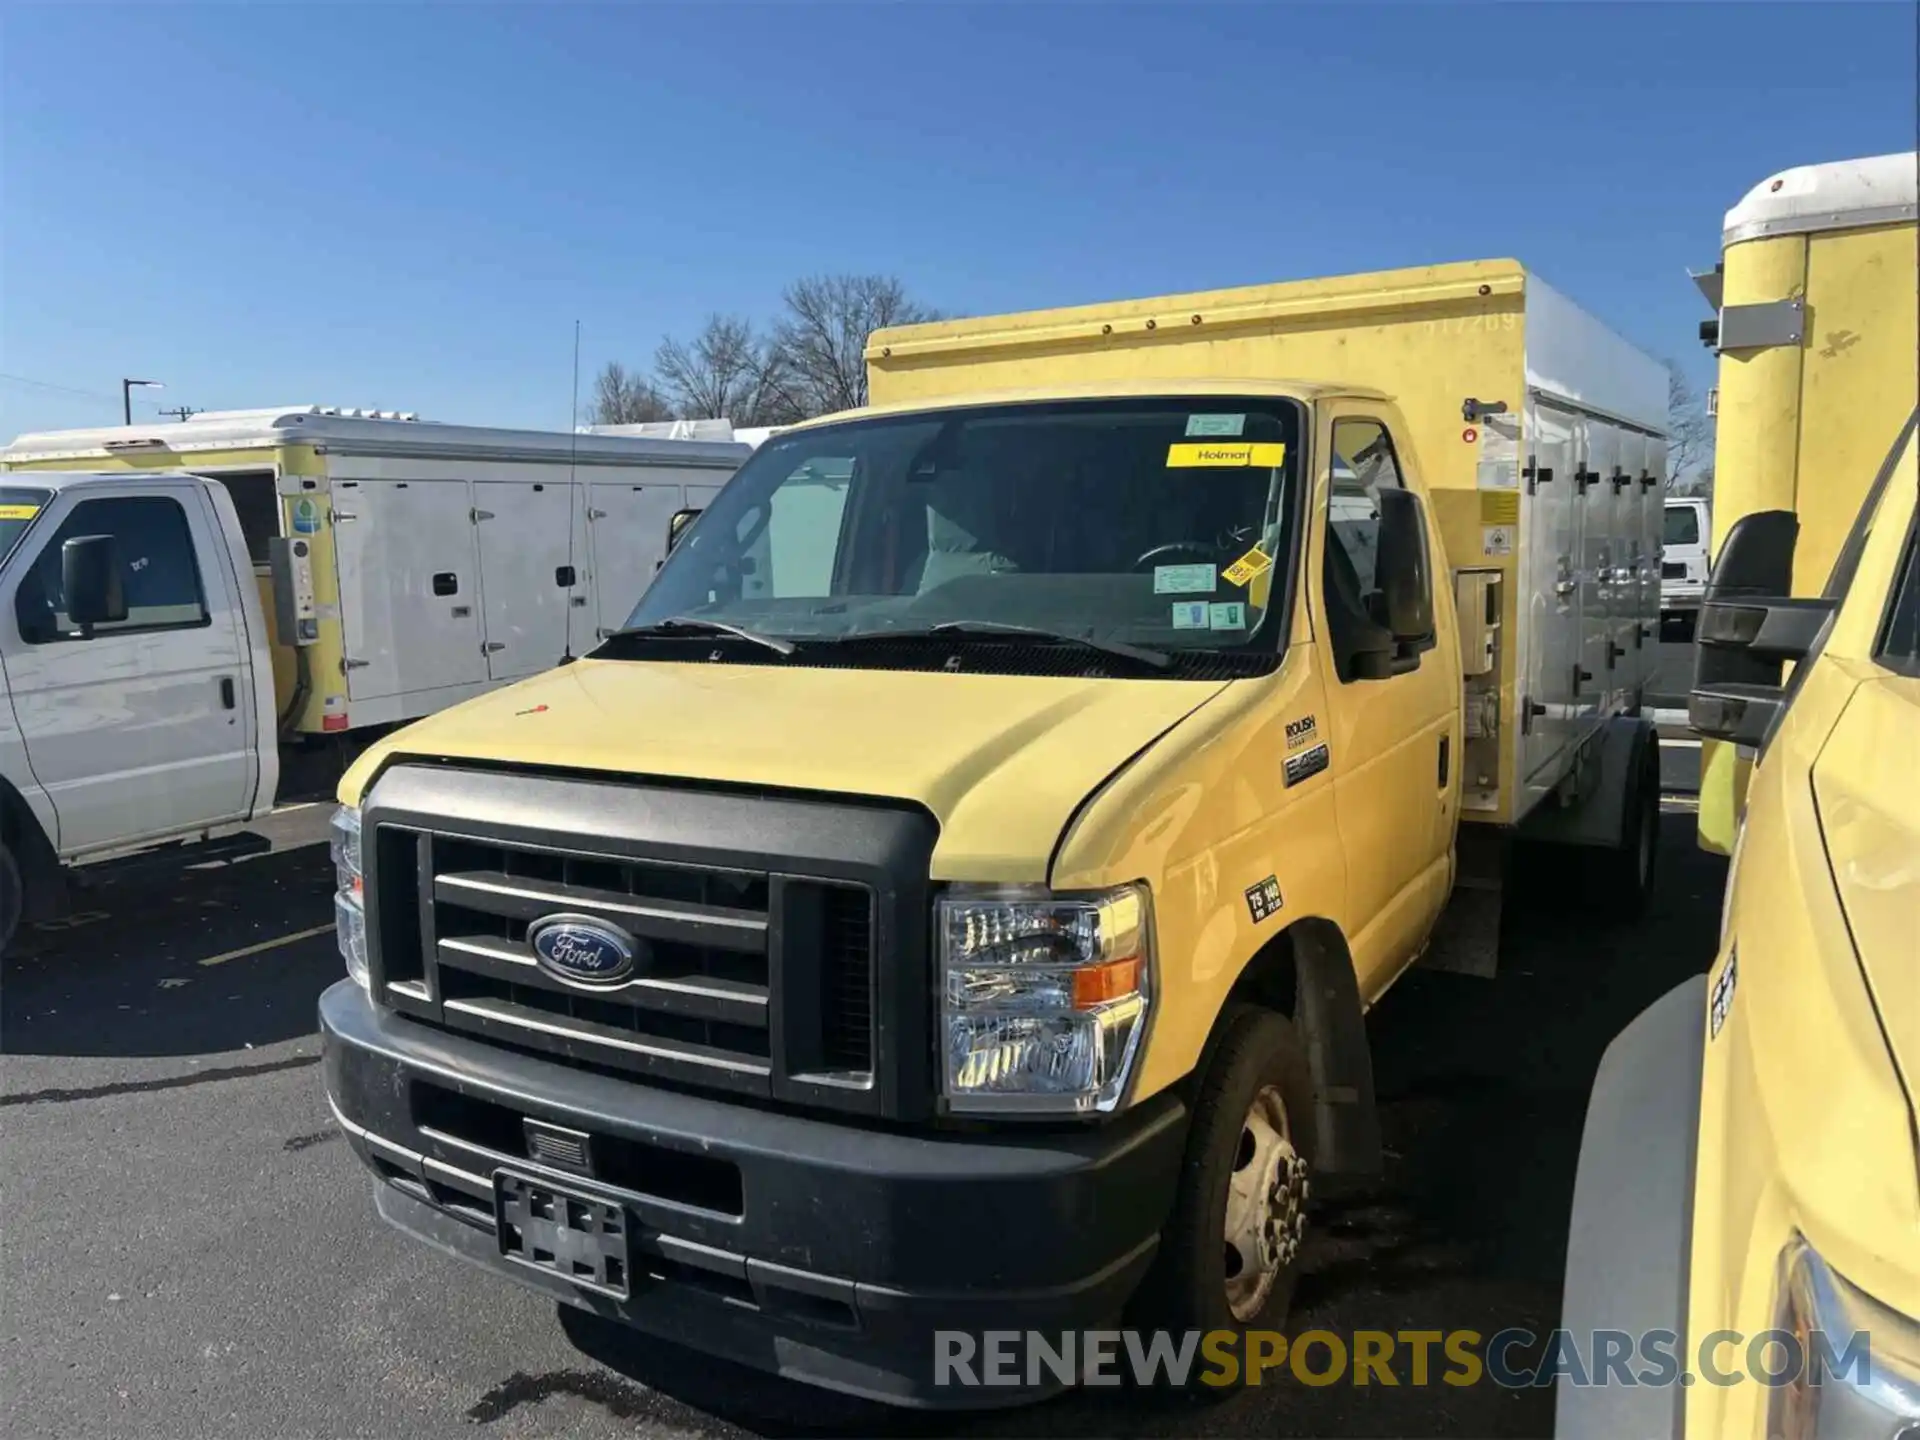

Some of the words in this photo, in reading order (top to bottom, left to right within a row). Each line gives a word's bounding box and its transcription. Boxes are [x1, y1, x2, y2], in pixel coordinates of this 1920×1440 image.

[1198, 450, 1250, 460] Holman
[1285, 714, 1316, 737] ROUSH
[1249, 891, 1263, 910] 75
[551, 933, 603, 968] Ford
